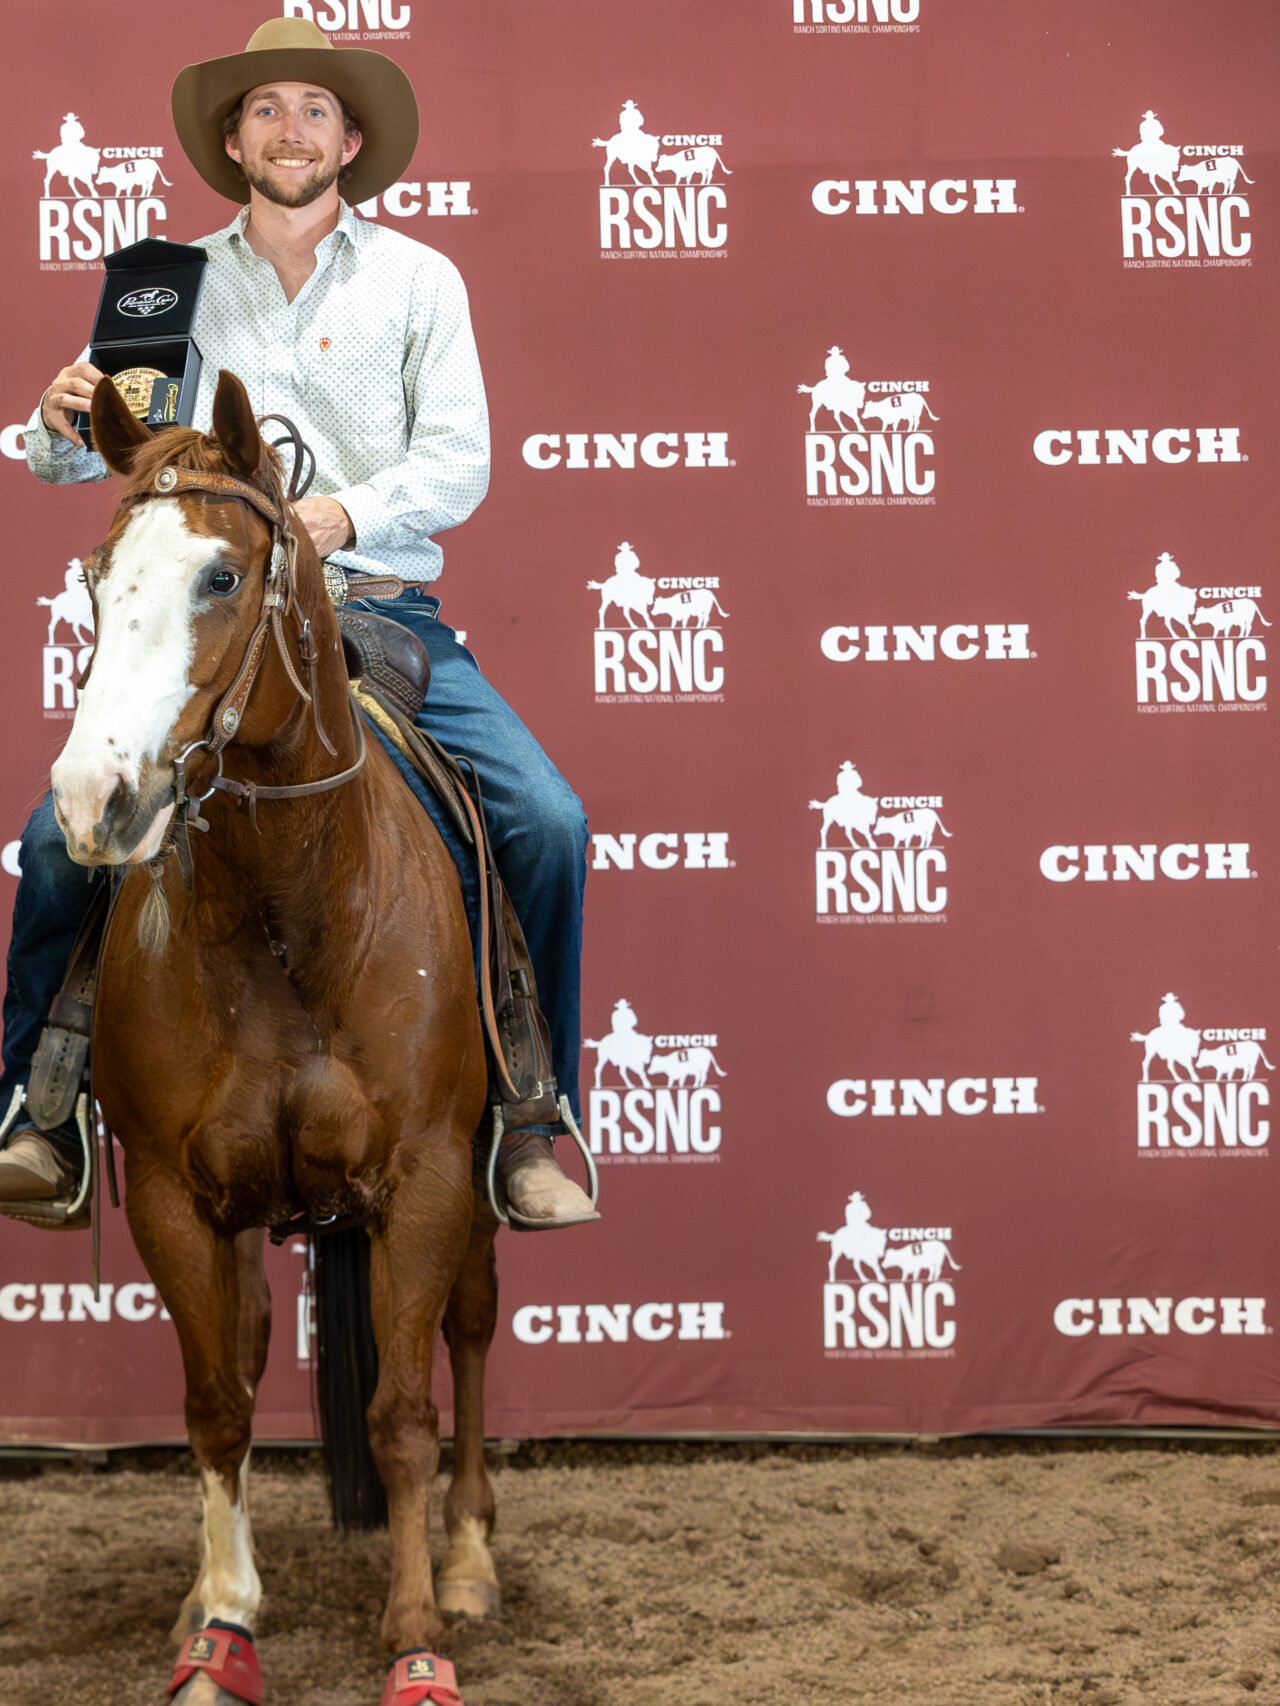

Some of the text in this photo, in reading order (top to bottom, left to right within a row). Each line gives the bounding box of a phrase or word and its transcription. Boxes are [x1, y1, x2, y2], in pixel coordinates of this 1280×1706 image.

[794, 24, 920, 34] RANCH SORTING NATIONAL CHAMPIONSHIPS
[102, 147, 163, 159] CINCH
[662, 135, 723, 146] CINCH
[1183, 145, 1244, 156] CINCH
[812, 179, 1018, 214] CINCH
[39, 198, 166, 260] RSNC
[599, 187, 727, 248] RSNC
[1121, 197, 1251, 257] RSNC
[601, 249, 727, 259] RANCH SORTING NATIONAL CHAMPIONSHIPS
[1124, 258, 1252, 269] RANCH SORTING NATIONAL CHAMPIONSHIPS
[868, 381, 930, 393] CINCH
[522, 432, 730, 469] CINCH
[805, 433, 935, 496] RSNC
[1033, 428, 1242, 465] CINCH
[807, 496, 936, 506] RANCH SORTING NATIONAL CHAMPIONSHIPS
[657, 577, 720, 589] CINCH
[1199, 586, 1262, 599] CINCH
[594, 630, 724, 692] RSNC
[821, 623, 1030, 662] CINCH
[1135, 639, 1267, 702] RSNC
[1137, 702, 1267, 714] RANCH SORTING NATIONAL CHAMPIONSHIPS
[880, 796, 943, 809] CINCH
[592, 832, 729, 870] NCH
[1040, 843, 1251, 882] CINCH
[816, 850, 947, 913] RSNC
[654, 1034, 718, 1048] CINCH
[1202, 1028, 1266, 1041] CINCH
[827, 1077, 1038, 1116] CINCH
[1137, 1082, 1270, 1147] RSNC
[589, 1088, 721, 1154] RSNC
[888, 1227, 952, 1241] CINCH
[512, 1301, 723, 1344] CINCH
[823, 1282, 955, 1348] RSNC
[1054, 1297, 1265, 1336] CINCH
